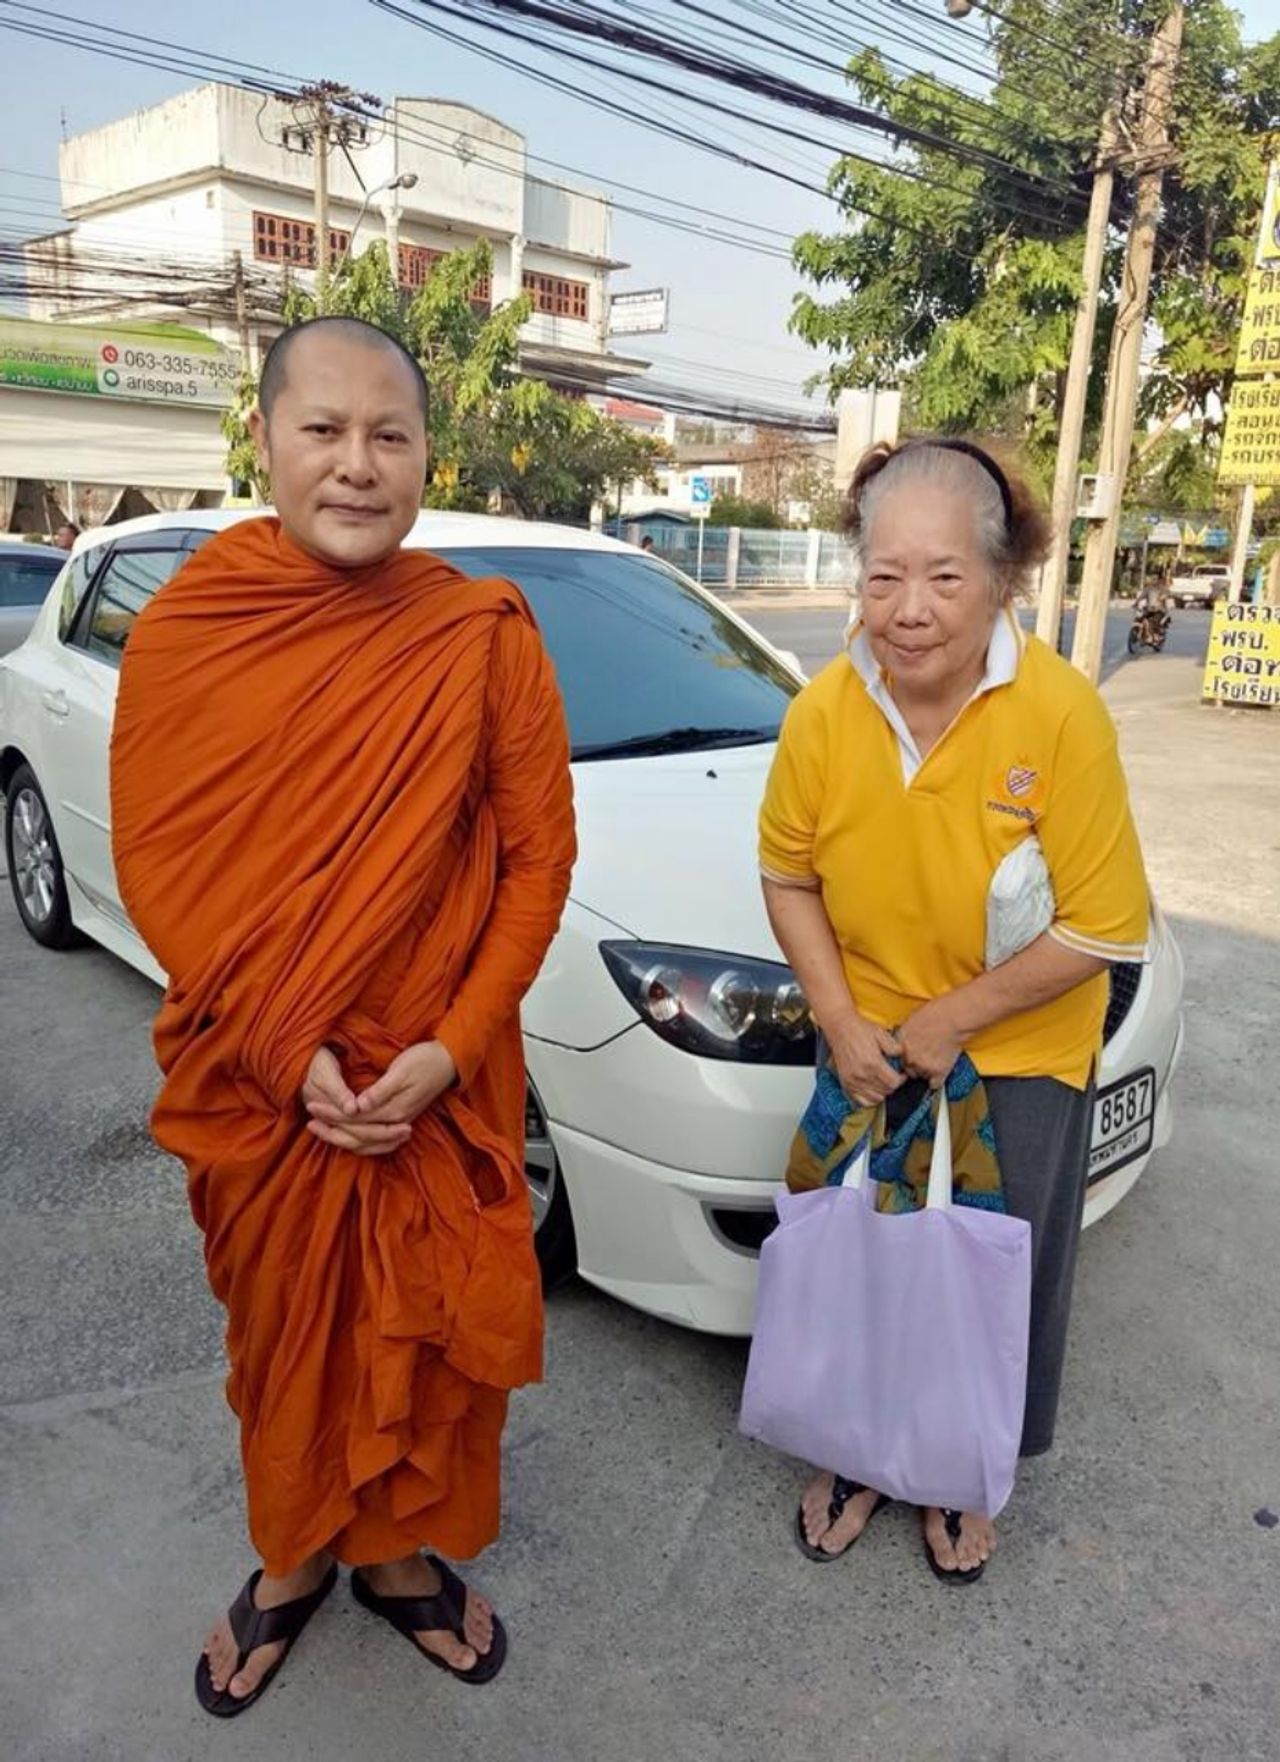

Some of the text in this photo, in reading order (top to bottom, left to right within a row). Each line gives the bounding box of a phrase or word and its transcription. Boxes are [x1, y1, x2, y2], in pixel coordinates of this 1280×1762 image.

[125, 350, 236, 379] 063-335-7555
[127, 376, 197, 396] arisspa.5
[1100, 1079, 1149, 1135] 8587
